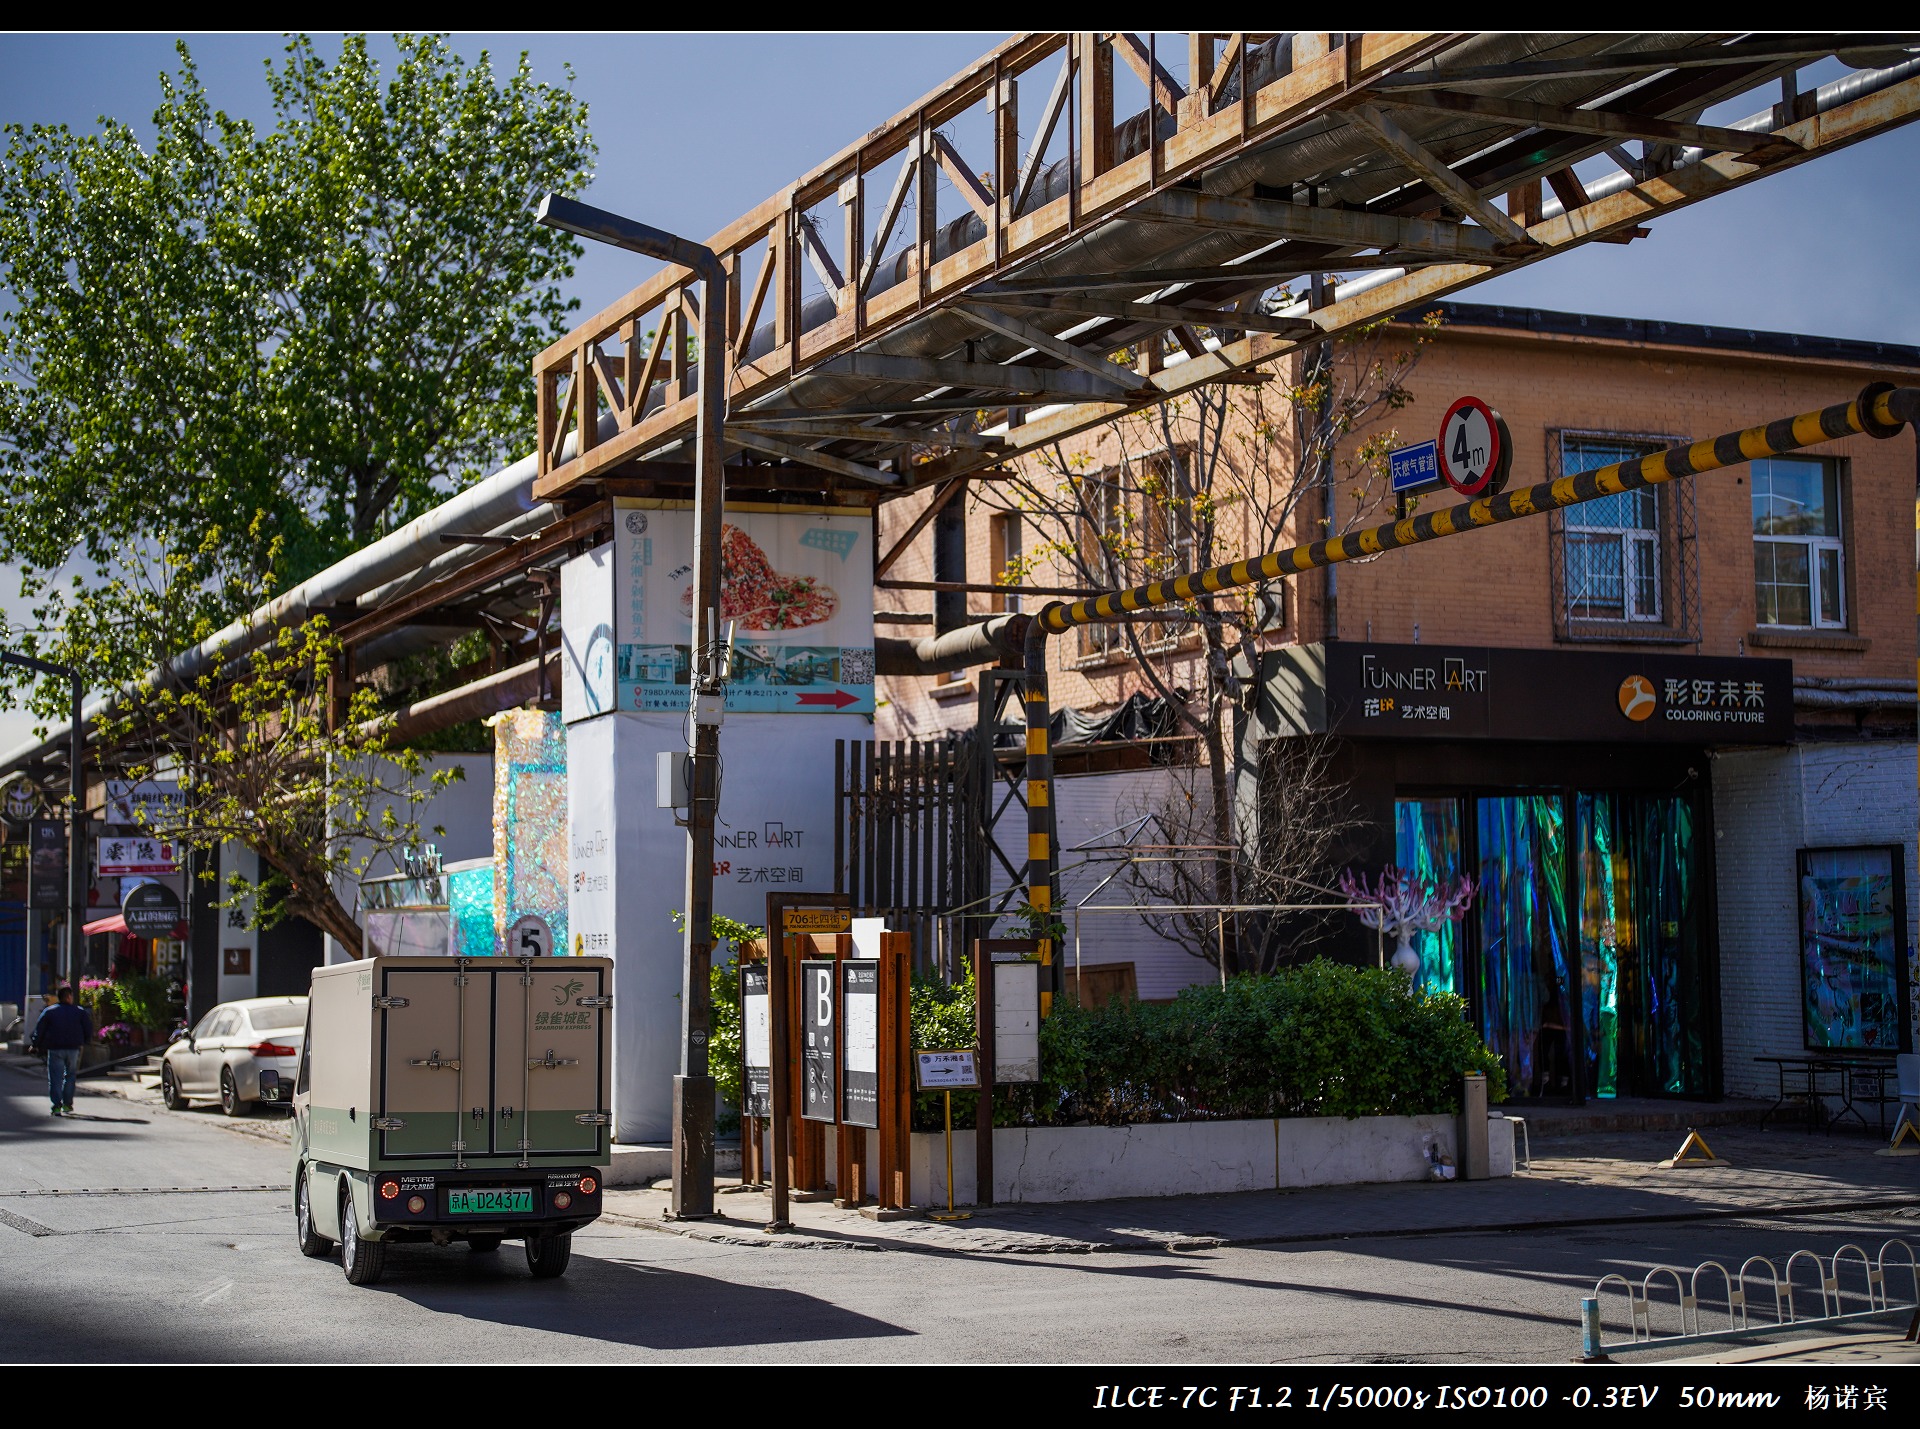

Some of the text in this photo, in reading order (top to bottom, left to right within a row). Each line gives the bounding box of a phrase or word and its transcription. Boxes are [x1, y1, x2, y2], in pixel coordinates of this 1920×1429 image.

[1452, 424, 1485, 469] 4m
[1363, 655, 1436, 690] FUNNER
[1402, 705, 1450, 720] 艺术空间
[1666, 709, 1765, 723] COLORING FUTURE
[737, 867, 803, 883] 艺术空间
[521, 928, 541, 957] 5
[817, 968, 832, 1026] B
[535, 1011, 591, 1025] 绿雀城配
